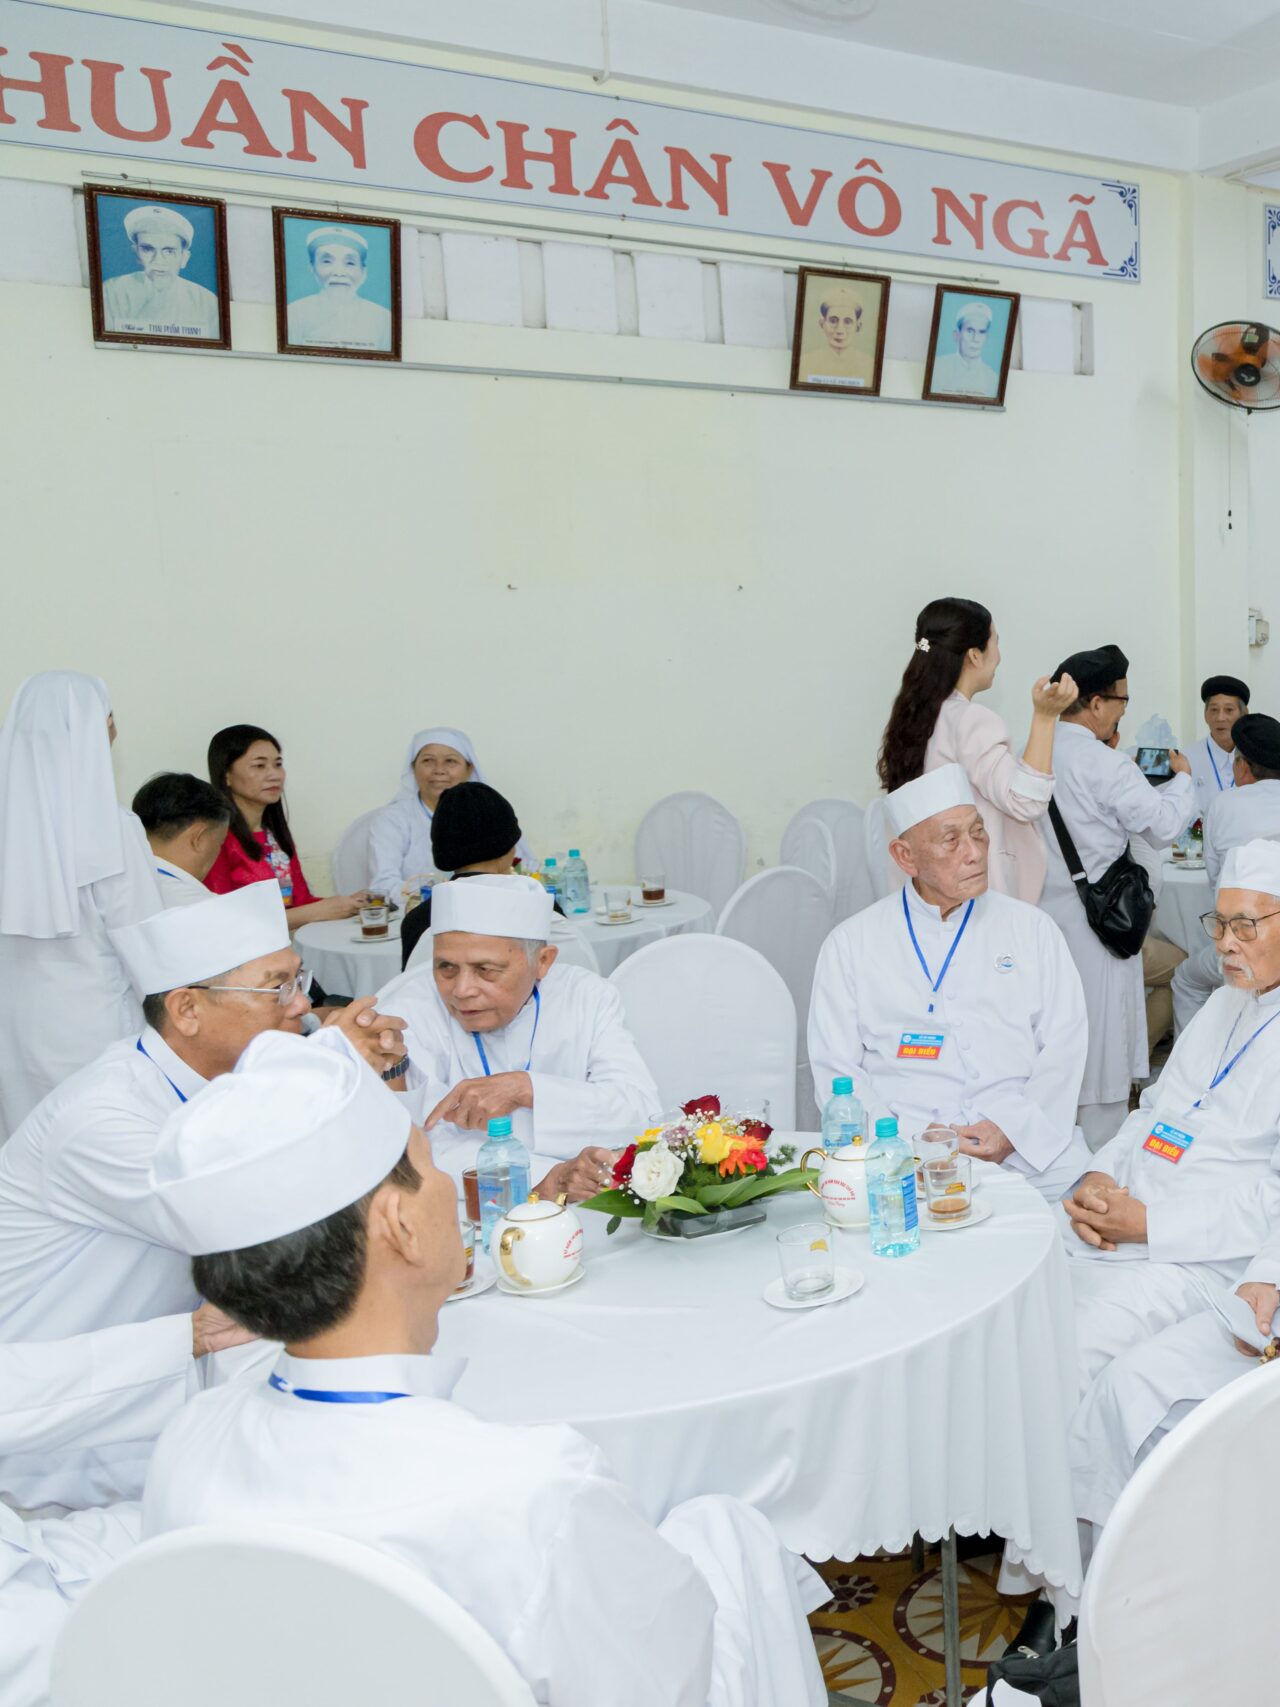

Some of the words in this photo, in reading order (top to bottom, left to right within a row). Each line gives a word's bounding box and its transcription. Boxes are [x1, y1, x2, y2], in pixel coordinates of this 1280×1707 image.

[0, 42, 370, 170] HUẦN
[413, 111, 733, 217] CHÂN
[762, 157, 903, 238] VÔ
[931, 186, 1110, 267] NGÃ
